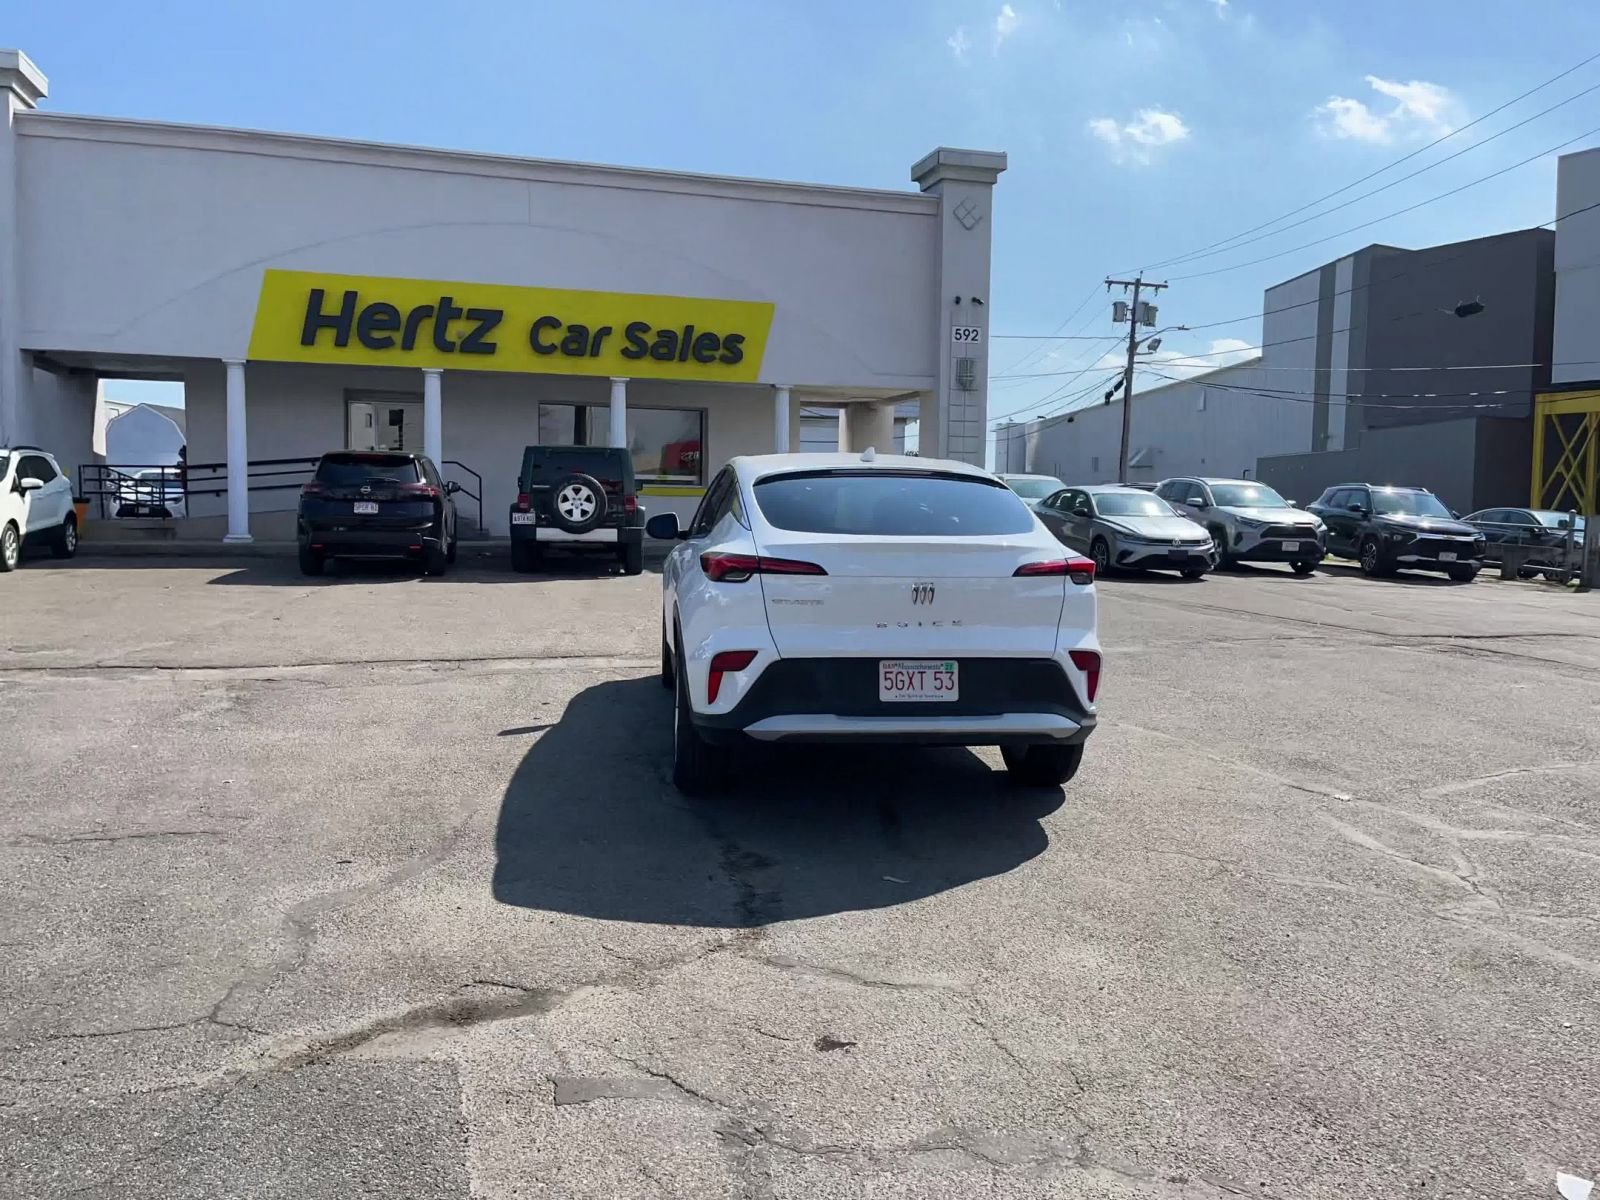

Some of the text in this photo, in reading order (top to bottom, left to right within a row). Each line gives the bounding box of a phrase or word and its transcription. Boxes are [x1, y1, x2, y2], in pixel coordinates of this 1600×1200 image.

[301, 288, 746, 365] Hertz Car Sales
[954, 328, 978, 341] 592
[884, 671, 955, 691] 5GXT 53
